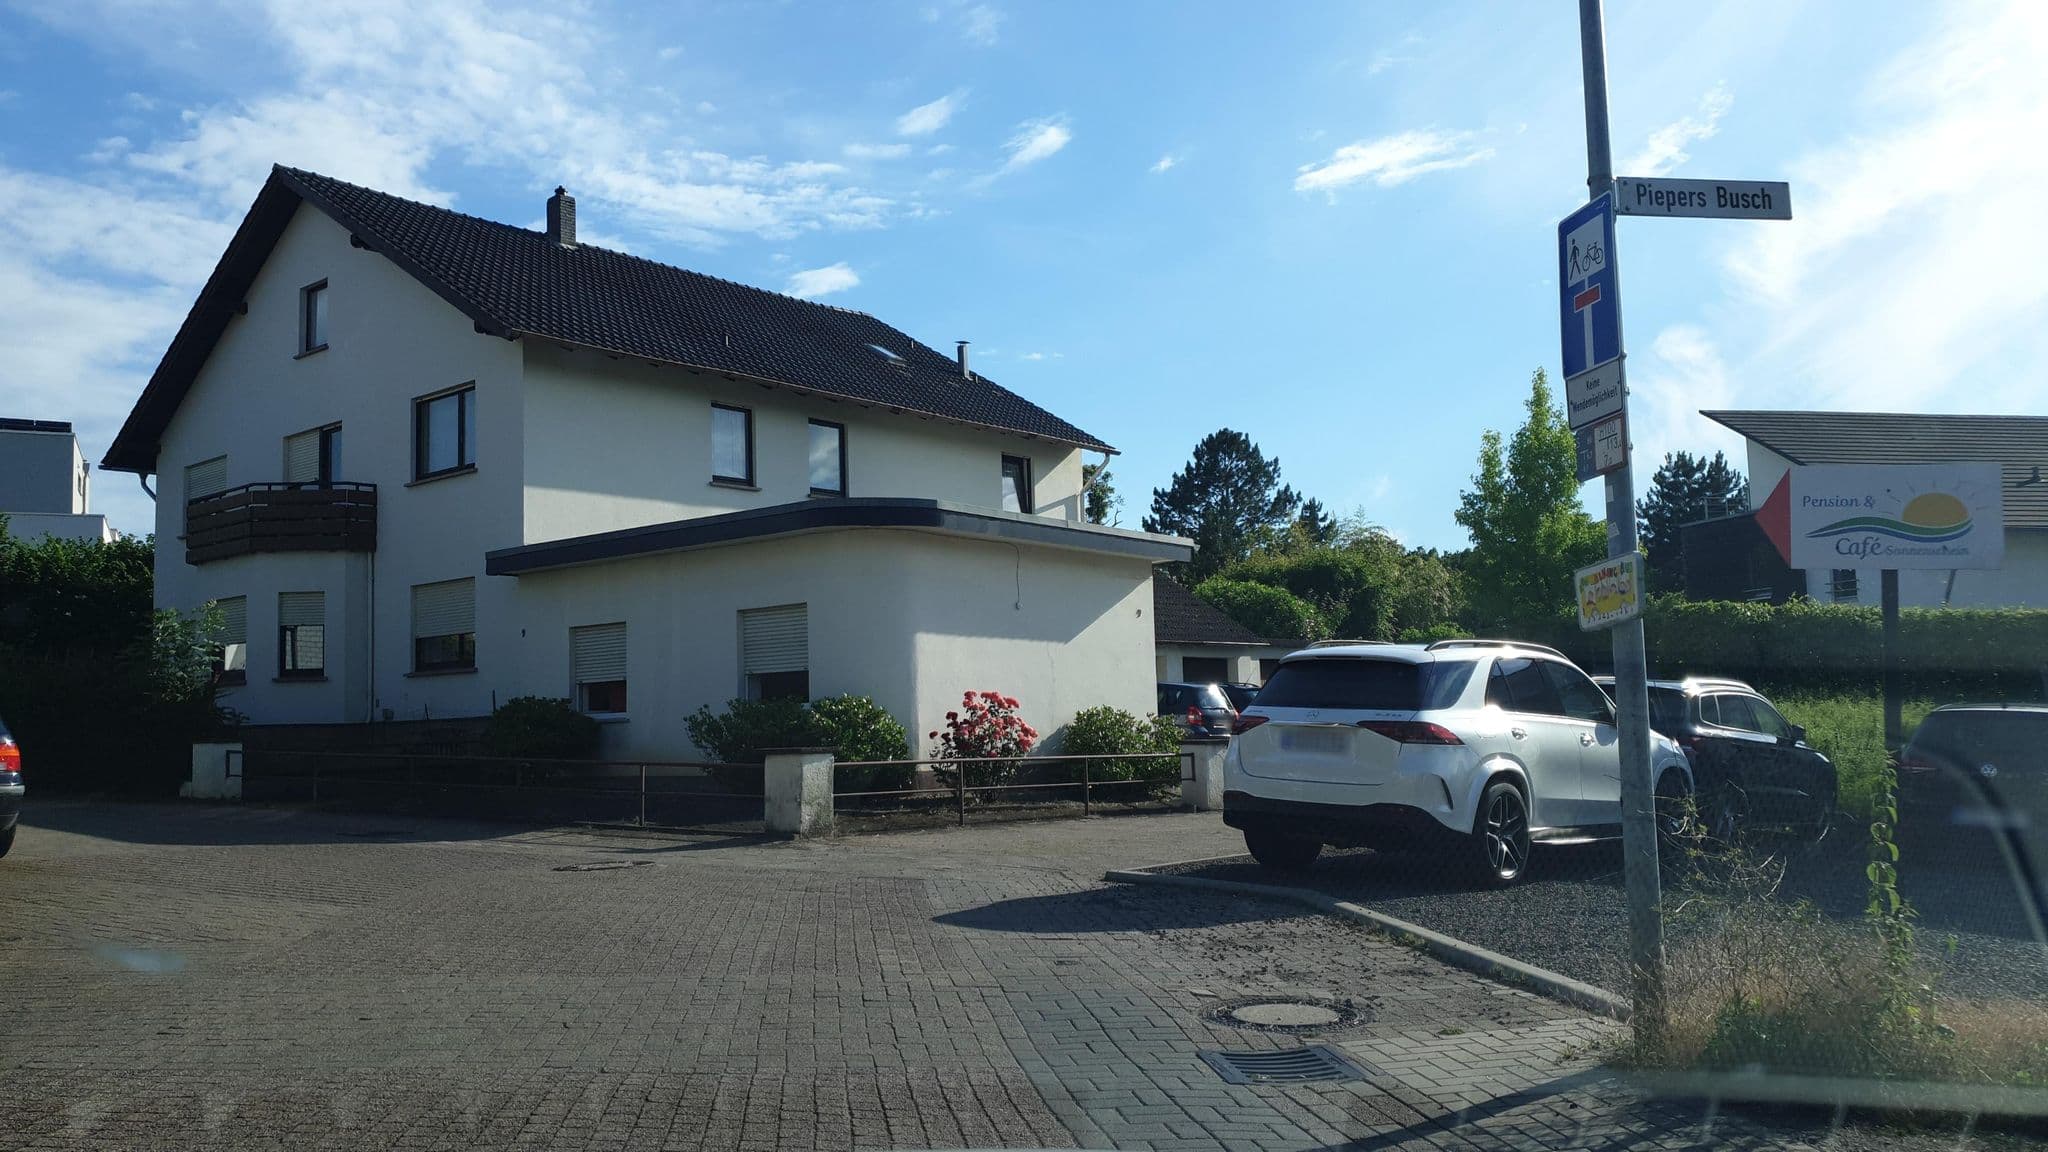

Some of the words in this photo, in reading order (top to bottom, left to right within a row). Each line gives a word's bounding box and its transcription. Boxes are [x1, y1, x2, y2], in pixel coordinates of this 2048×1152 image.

[1636, 183, 1707, 212] Piepers
[1716, 186, 1772, 209] Busch
[1586, 378, 1600, 391] Keine
[1802, 495, 1859, 508] Pension
[1864, 495, 1876, 508] &
[1836, 537, 1882, 560] Café
